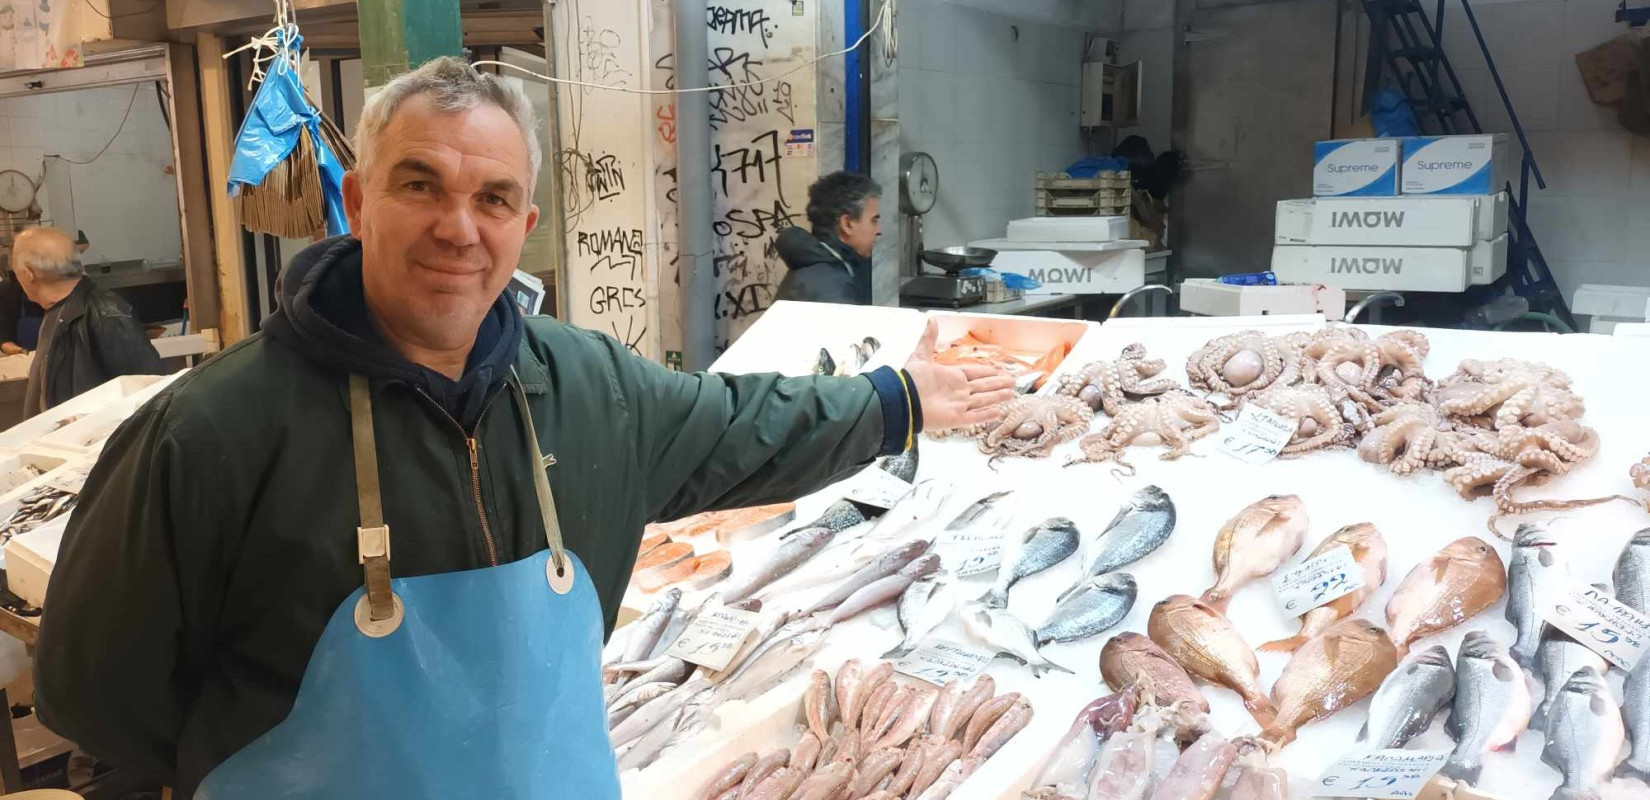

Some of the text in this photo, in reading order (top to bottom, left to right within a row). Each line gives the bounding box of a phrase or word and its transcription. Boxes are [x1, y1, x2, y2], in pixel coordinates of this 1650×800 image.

[1327, 163, 1380, 174] Supreme
[1417, 160, 1473, 172] Supreme
[1331, 211, 1405, 228] MOWI
[1330, 258, 1404, 274] MOWI
[1029, 268, 1092, 283] MOWI
